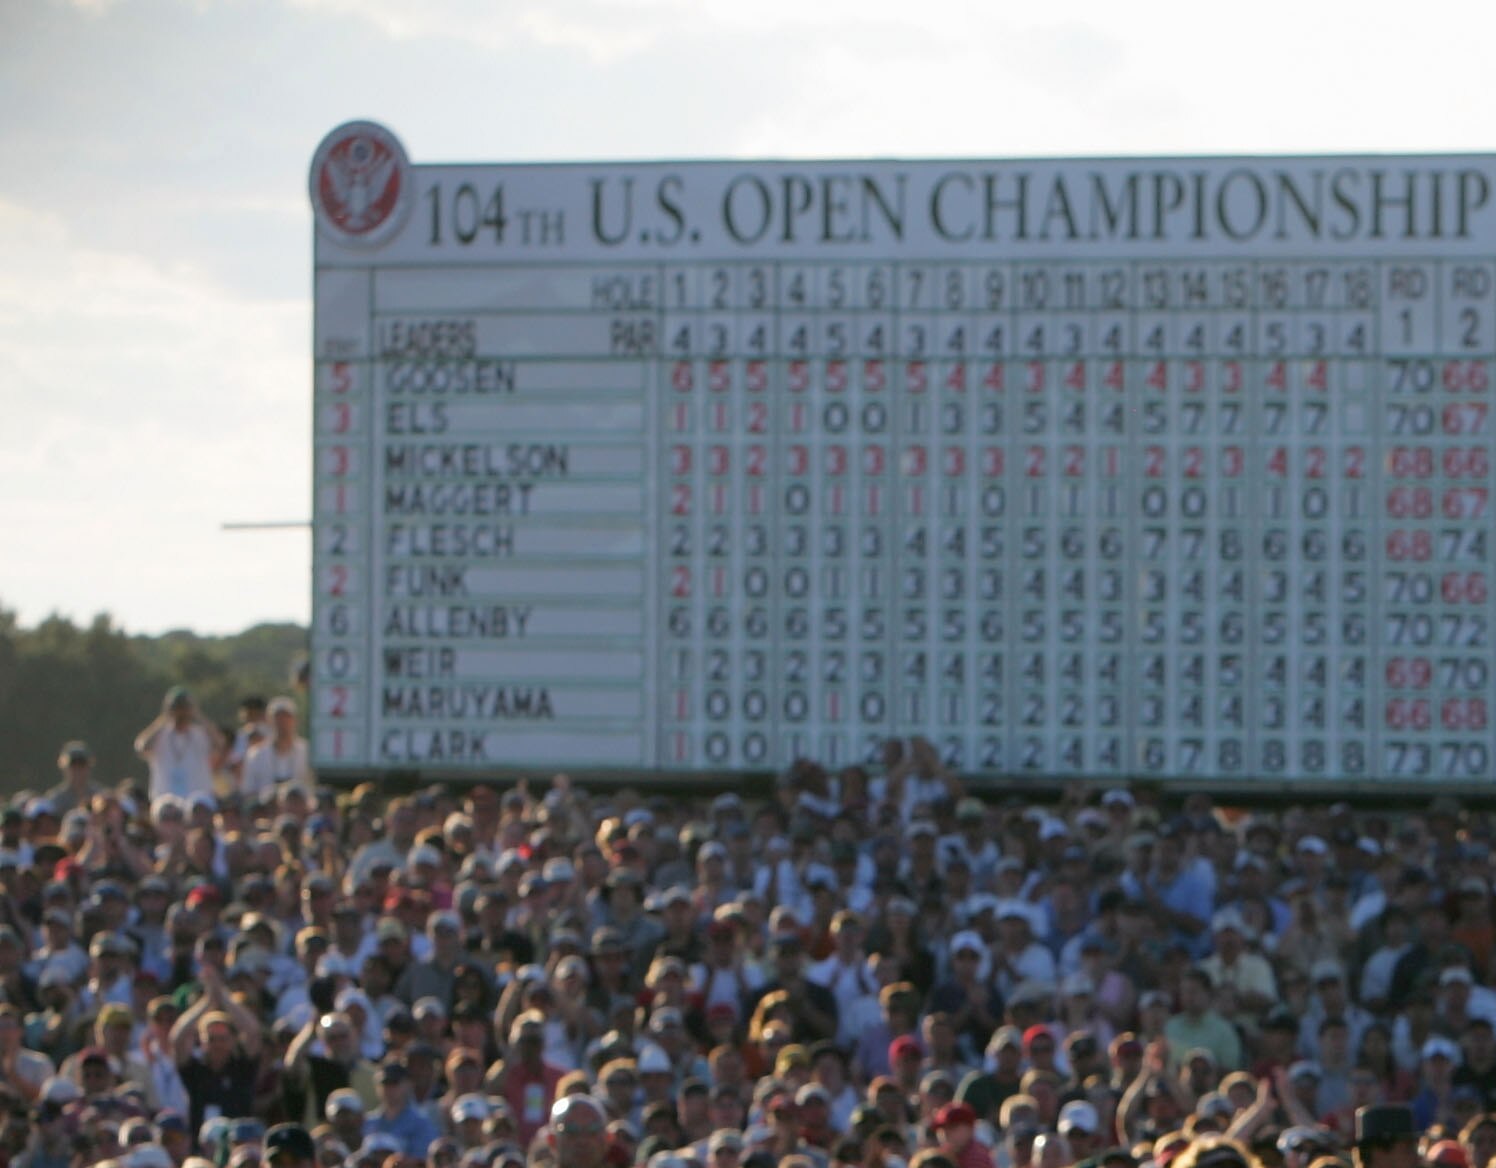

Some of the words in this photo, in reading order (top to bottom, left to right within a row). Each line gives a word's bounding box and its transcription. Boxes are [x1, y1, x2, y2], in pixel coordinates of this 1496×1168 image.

[590, 177, 701, 246] U.S.
[721, 172, 909, 245] OPEN
[928, 167, 1492, 244] CHAMPIONSHIP
[591, 277, 658, 308] HOLE
[1389, 268, 1426, 299] RD
[1452, 267, 1490, 299] RD
[380, 322, 477, 358] LEADERS
[610, 322, 658, 351] PAR
[672, 325, 692, 355] 4
[708, 324, 730, 355] 3
[749, 325, 769, 355] 4
[790, 325, 808, 355] 4
[826, 323, 846, 355] 5
[867, 325, 884, 355] 4
[908, 325, 925, 355] 3
[947, 326, 965, 355] 4
[985, 326, 1003, 355] 4
[1027, 325, 1046, 355] 4
[1063, 324, 1082, 355] 3
[1104, 325, 1124, 355] 4
[1146, 325, 1164, 355] 4
[1186, 324, 1206, 355] 4
[1226, 324, 1247, 355] 4
[1266, 323, 1286, 355] 5
[1304, 323, 1328, 355] 3
[1347, 324, 1368, 355] 4
[1398, 308, 1413, 346] 1
[1460, 308, 1482, 347] 2
[333, 361, 351, 393] 5
[386, 363, 515, 394] GOOSEN
[672, 361, 693, 391] 6
[708, 361, 730, 391] 5
[747, 361, 768, 391] 5
[788, 361, 809, 391] 5
[826, 361, 847, 391] 5
[864, 361, 885, 390] 5
[907, 361, 928, 393] 5
[947, 361, 966, 392] 4
[984, 361, 1005, 391] 4
[1025, 361, 1048, 393] 3
[1066, 361, 1085, 390] 4
[1104, 361, 1124, 391] 4
[1149, 360, 1167, 390] 4
[1183, 360, 1206, 392] 3
[1221, 360, 1245, 393] 3
[1266, 360, 1287, 391] 4
[1309, 360, 1328, 391] 4
[1385, 360, 1436, 393] 70
[1442, 360, 1488, 392] 66
[334, 403, 350, 434] 3
[386, 403, 448, 433] ELS
[1387, 404, 1436, 435] 70
[1440, 403, 1488, 435] 67
[332, 446, 348, 476] 3
[386, 445, 569, 476] MICKELSON
[1392, 446, 1435, 479] 68
[1442, 447, 1488, 478] 66
[384, 486, 535, 515] MAGGERT
[1386, 488, 1434, 519] 68
[1441, 487, 1488, 519] 67
[330, 525, 346, 555] 2
[386, 526, 514, 556] FLESCH
[1386, 531, 1432, 561] 68
[1441, 529, 1487, 561] 74
[329, 566, 346, 596] 2
[386, 568, 468, 597] FUNK
[1384, 572, 1436, 603] 70
[1440, 573, 1487, 603] 66
[330, 607, 348, 636] 6
[384, 609, 532, 638] ALLENBY
[1386, 613, 1434, 646] 70
[1440, 614, 1487, 646] 72
[328, 646, 349, 675] 0
[382, 649, 457, 676] WEIR
[1386, 658, 1432, 688] 69
[1440, 658, 1488, 689] 70
[330, 686, 345, 716] 2
[382, 689, 554, 720] MARUYAMA
[1385, 699, 1431, 730] 66
[1440, 699, 1487, 730] 68
[381, 734, 489, 760] CLARK
[940, 737, 963, 768] 2
[980, 738, 1002, 769] 2
[1022, 738, 1042, 769] 2
[1063, 739, 1083, 768] 4
[1100, 739, 1120, 767] 4
[1144, 739, 1165, 771] 6
[1181, 739, 1204, 769] 7
[1220, 740, 1242, 770] 8
[1262, 741, 1286, 771] 8
[1302, 741, 1325, 771] 8
[1343, 742, 1365, 774] 8
[1385, 742, 1432, 775] 73
[1440, 742, 1488, 776] 70
